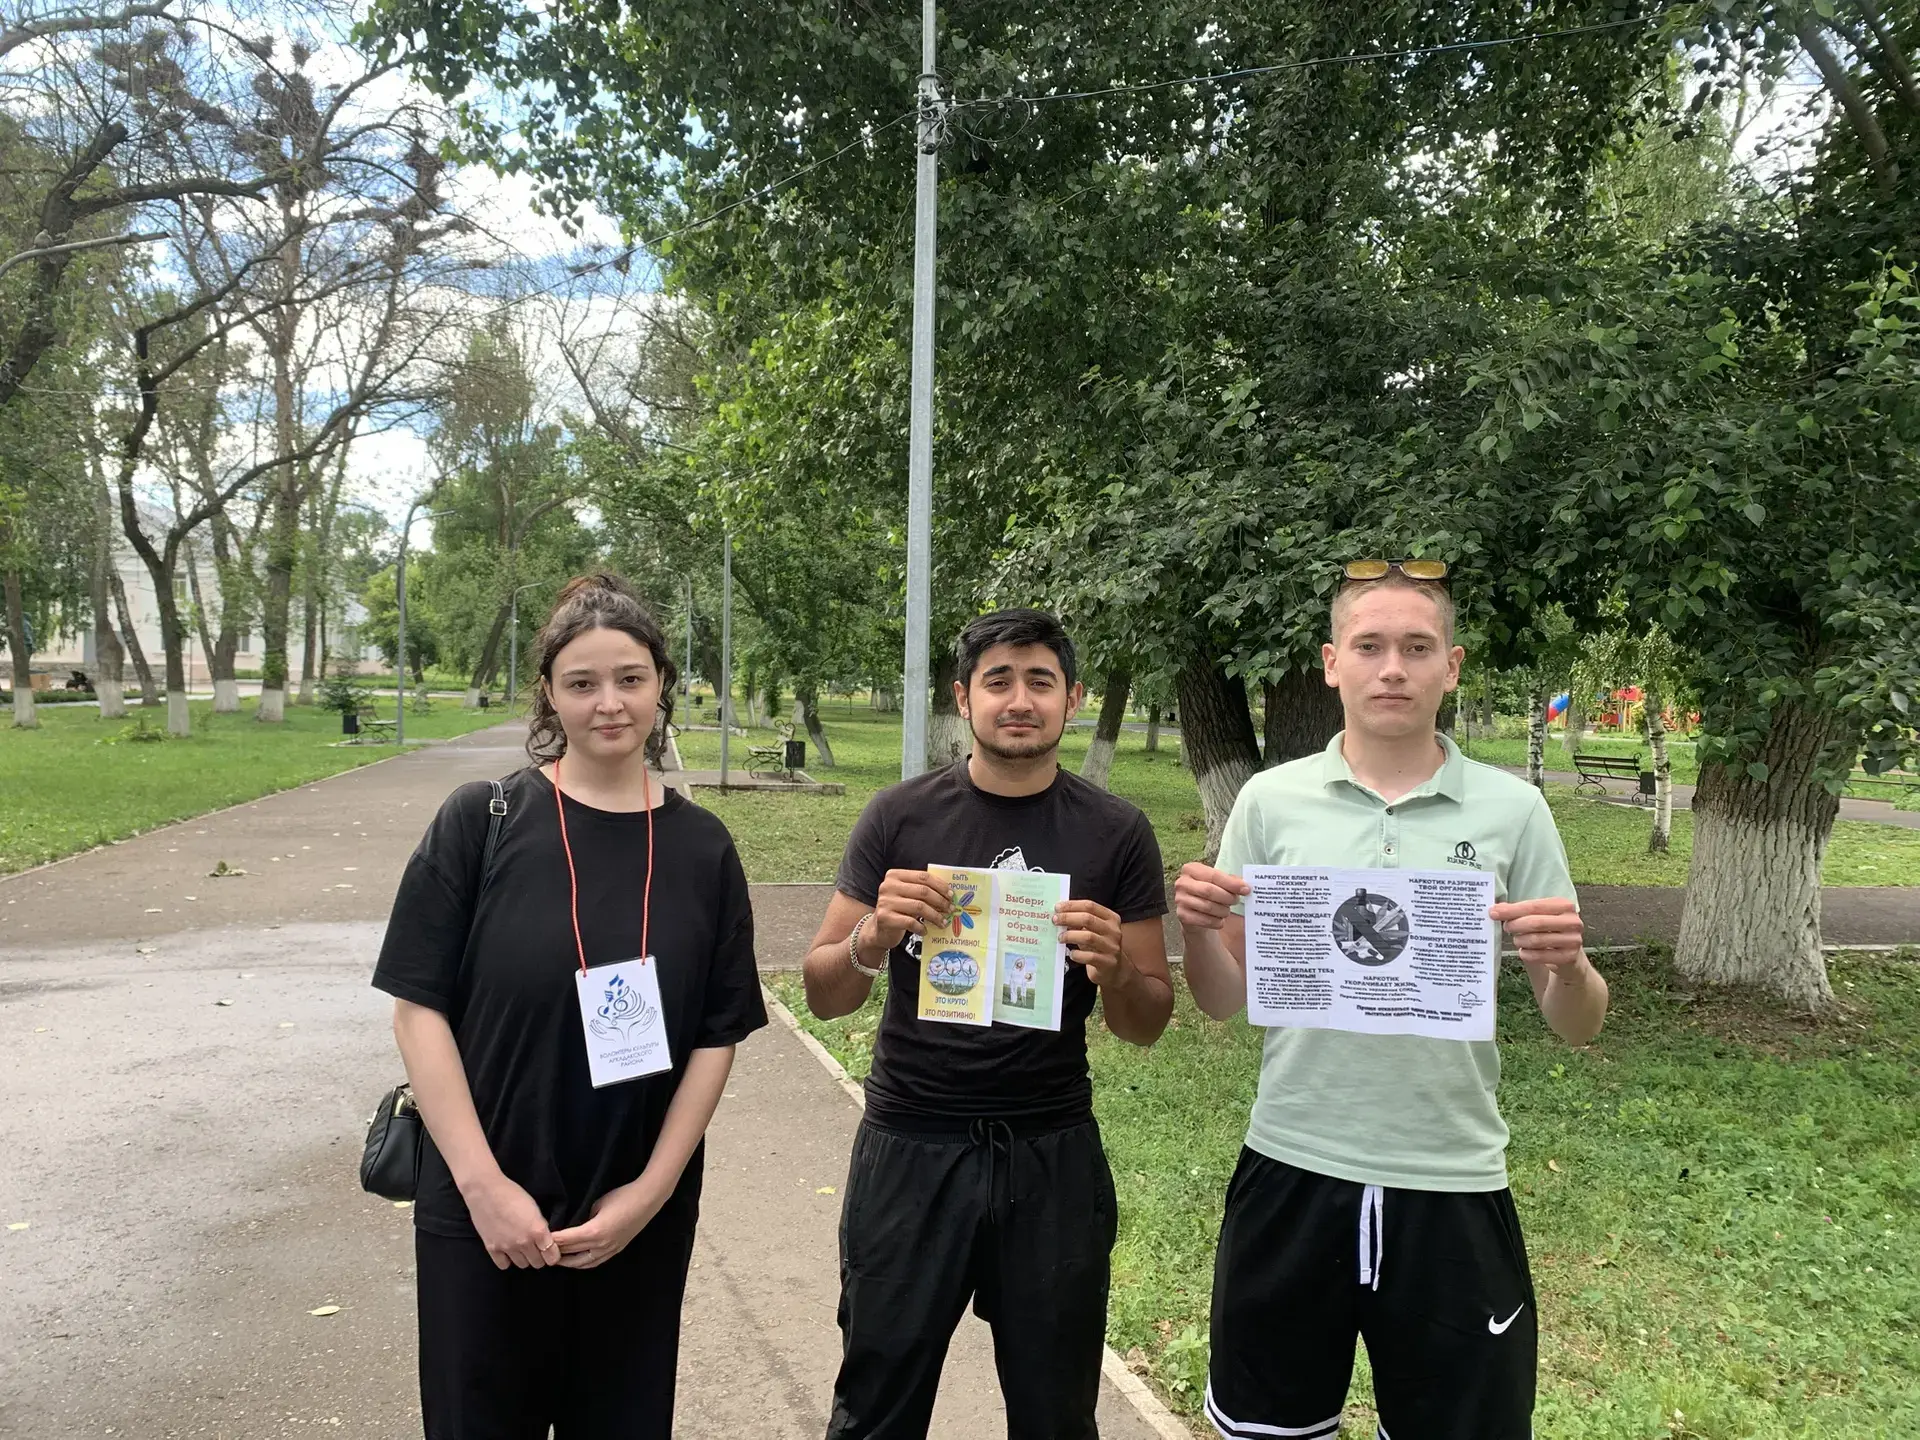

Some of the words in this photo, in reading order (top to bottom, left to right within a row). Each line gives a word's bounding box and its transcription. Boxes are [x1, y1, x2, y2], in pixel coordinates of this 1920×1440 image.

[952, 873, 968, 881] БЫТЬ
[949, 883, 977, 891] ОРОВЫМ!
[1005, 894, 1044, 906] Выбери
[999, 907, 1050, 920] здоровый
[1007, 922, 1038, 932] образ
[950, 938, 980, 947] АКТИВНО!
[1006, 934, 1038, 945] жизни
[948, 998, 968, 1006] КРУТО!
[937, 1010, 975, 1020] ПОЗИТИВНО!
[633, 1042, 659, 1051] КУЛЬТУРЫ
